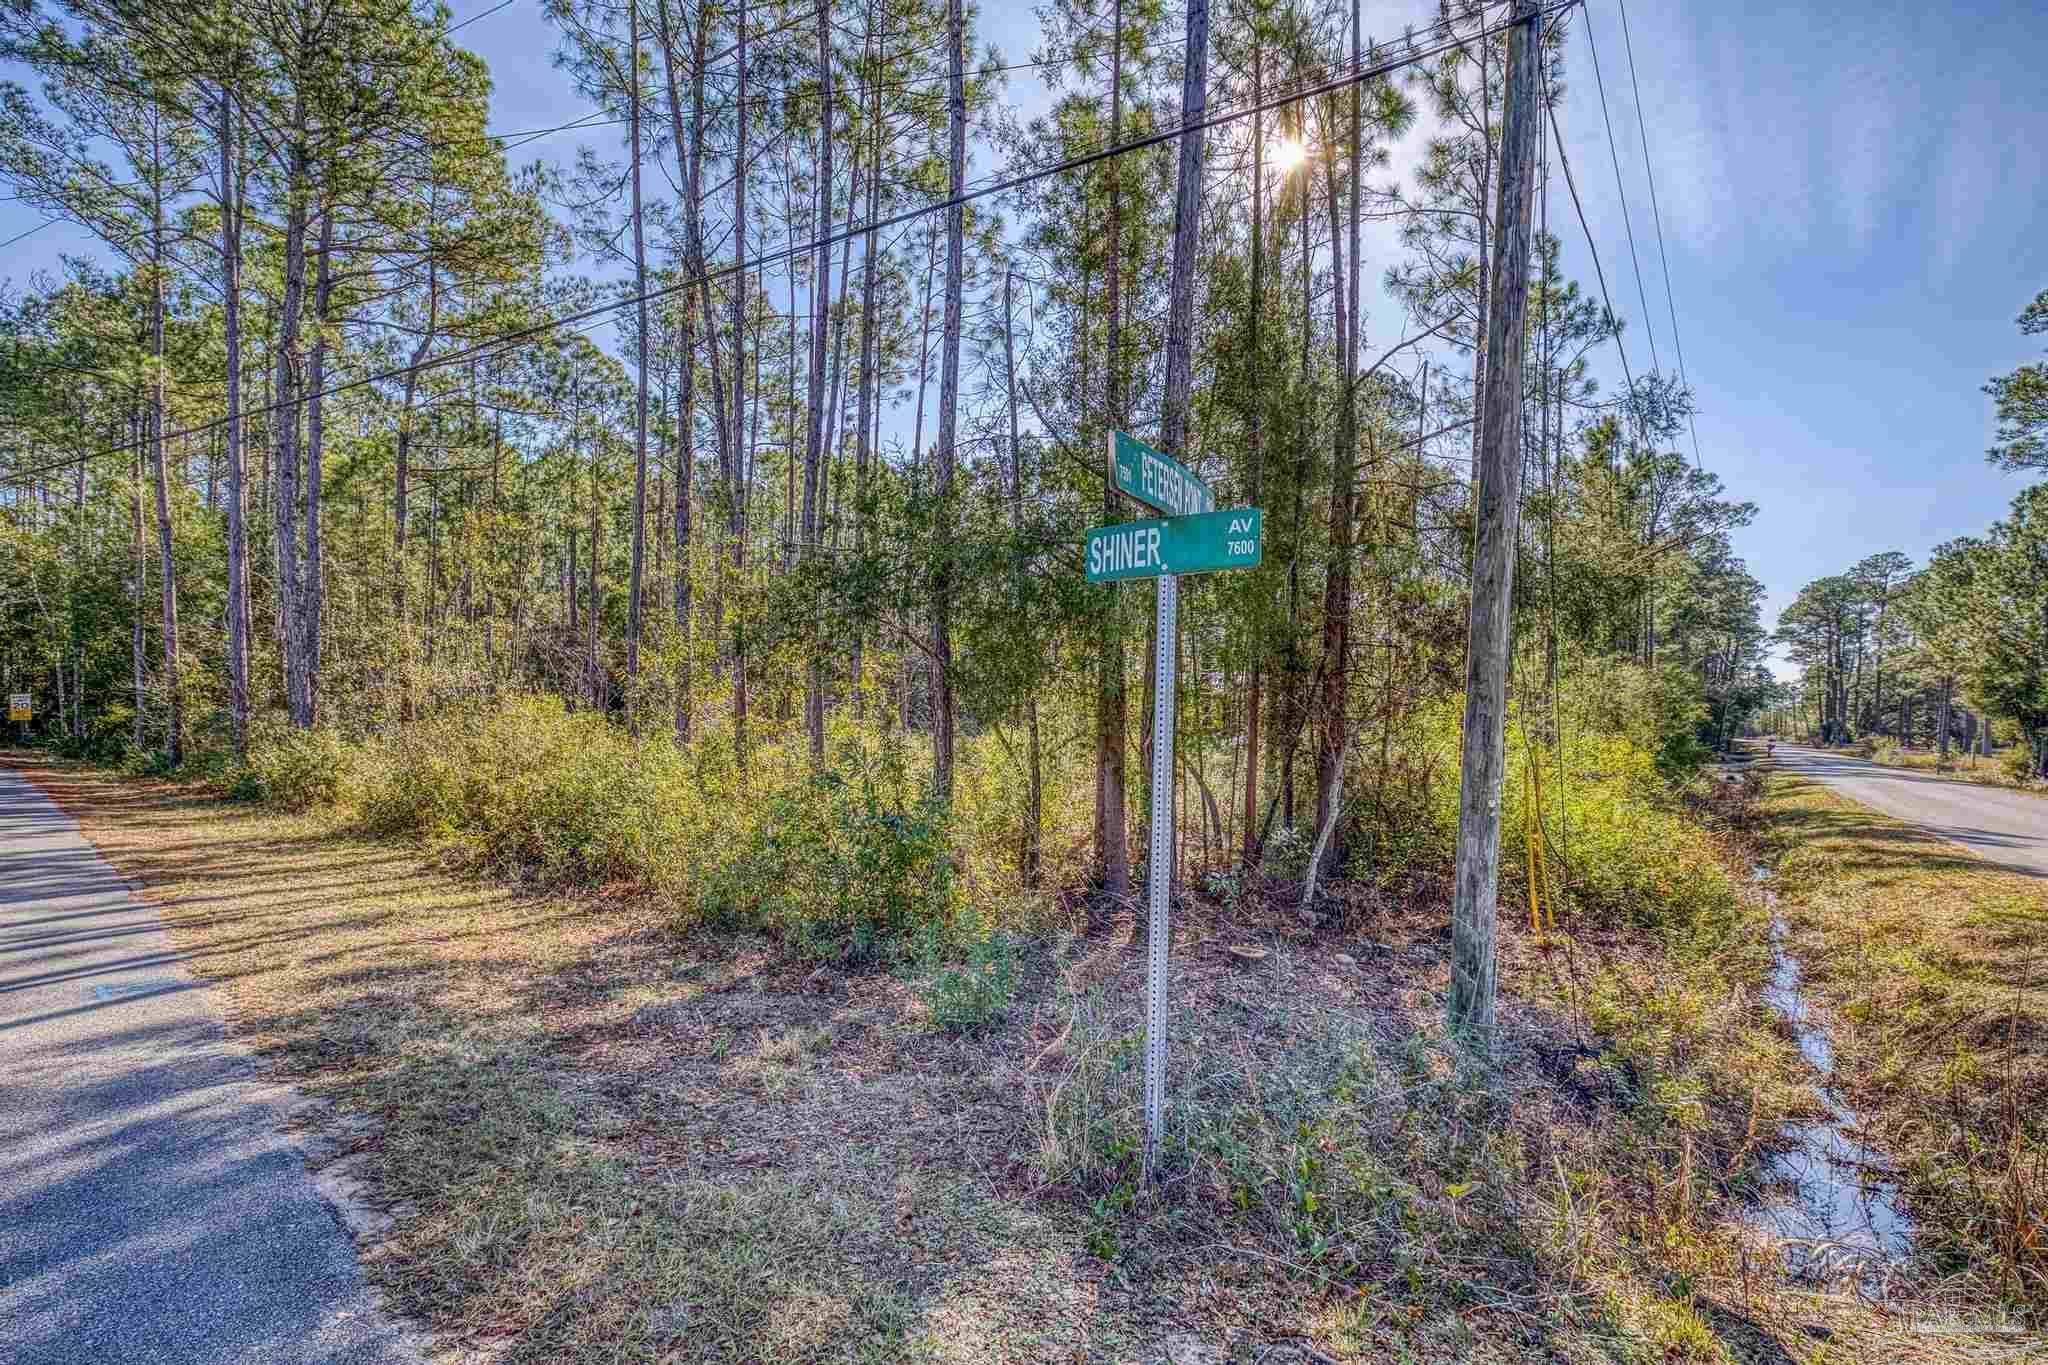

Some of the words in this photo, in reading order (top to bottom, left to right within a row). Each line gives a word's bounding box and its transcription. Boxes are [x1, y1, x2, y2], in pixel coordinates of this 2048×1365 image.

[1228, 517, 1253, 534] AV
[1090, 528, 1161, 575] SHINER
[1227, 539, 1255, 556] 7600
